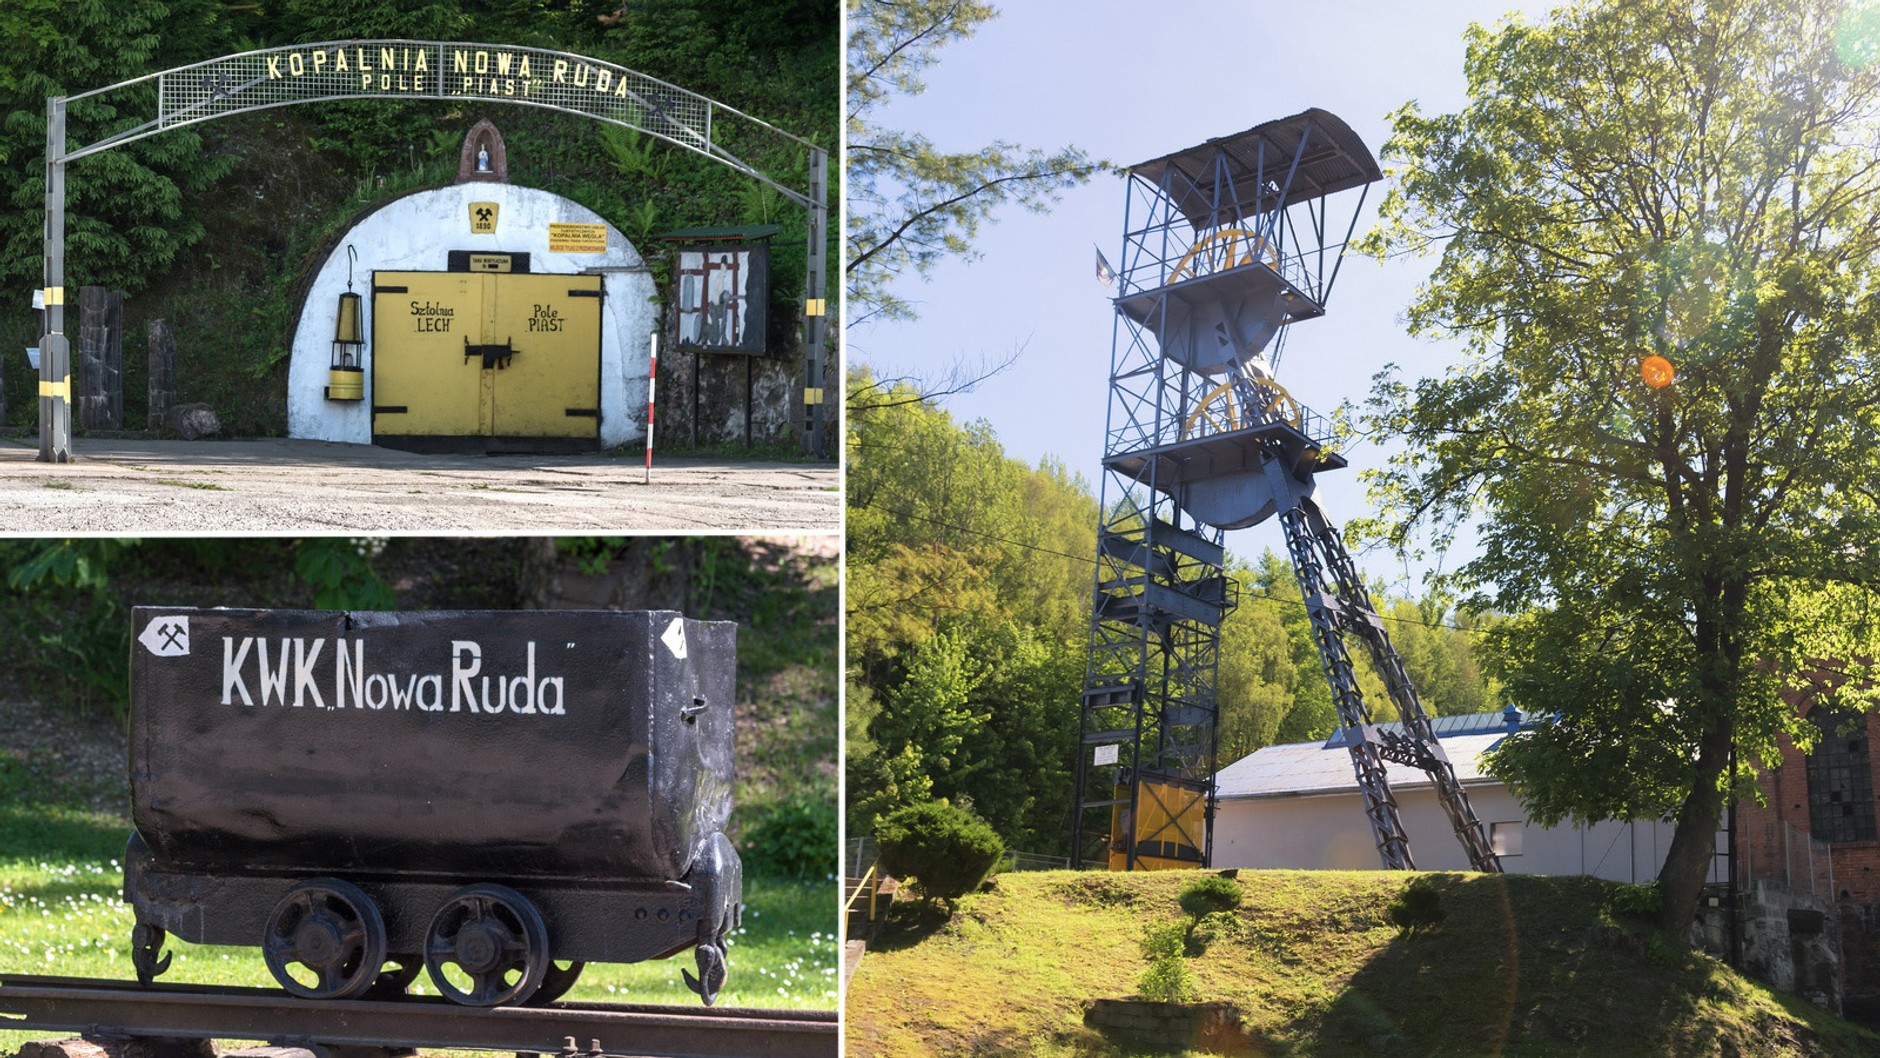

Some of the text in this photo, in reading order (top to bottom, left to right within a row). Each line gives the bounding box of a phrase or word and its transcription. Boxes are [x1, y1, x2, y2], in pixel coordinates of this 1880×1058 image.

[267, 48, 627, 98] KOPALNIA NOWA RUDA
[362, 74, 424, 91] POLE
[410, 301, 454, 316] Sztolnia
[533, 304, 558, 318] Pole
[220, 636, 326, 708] KWK
